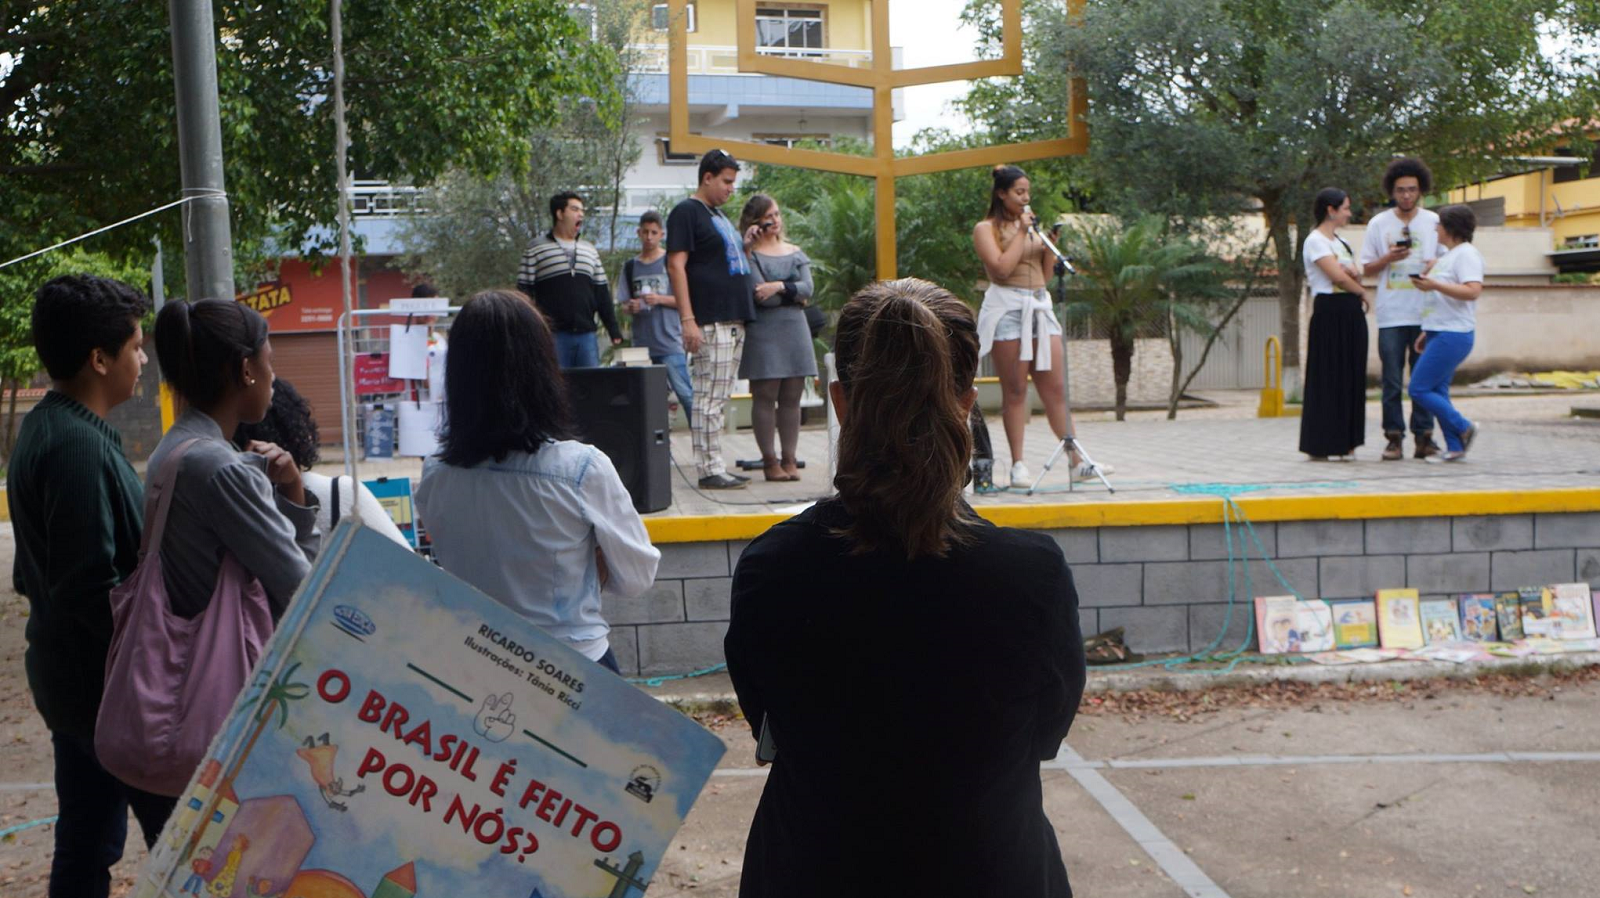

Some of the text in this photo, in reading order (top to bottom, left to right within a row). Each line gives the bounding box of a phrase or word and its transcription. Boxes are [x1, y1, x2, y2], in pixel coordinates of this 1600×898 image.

[239, 286, 291, 311] TATA
[464, 636, 582, 711] Ilustrações: Tânia Ricci
[478, 624, 585, 694] RICARDO SOARES
[317, 669, 622, 853] O BRASIL É FEITO
[357, 747, 539, 863] POR NÓS?
